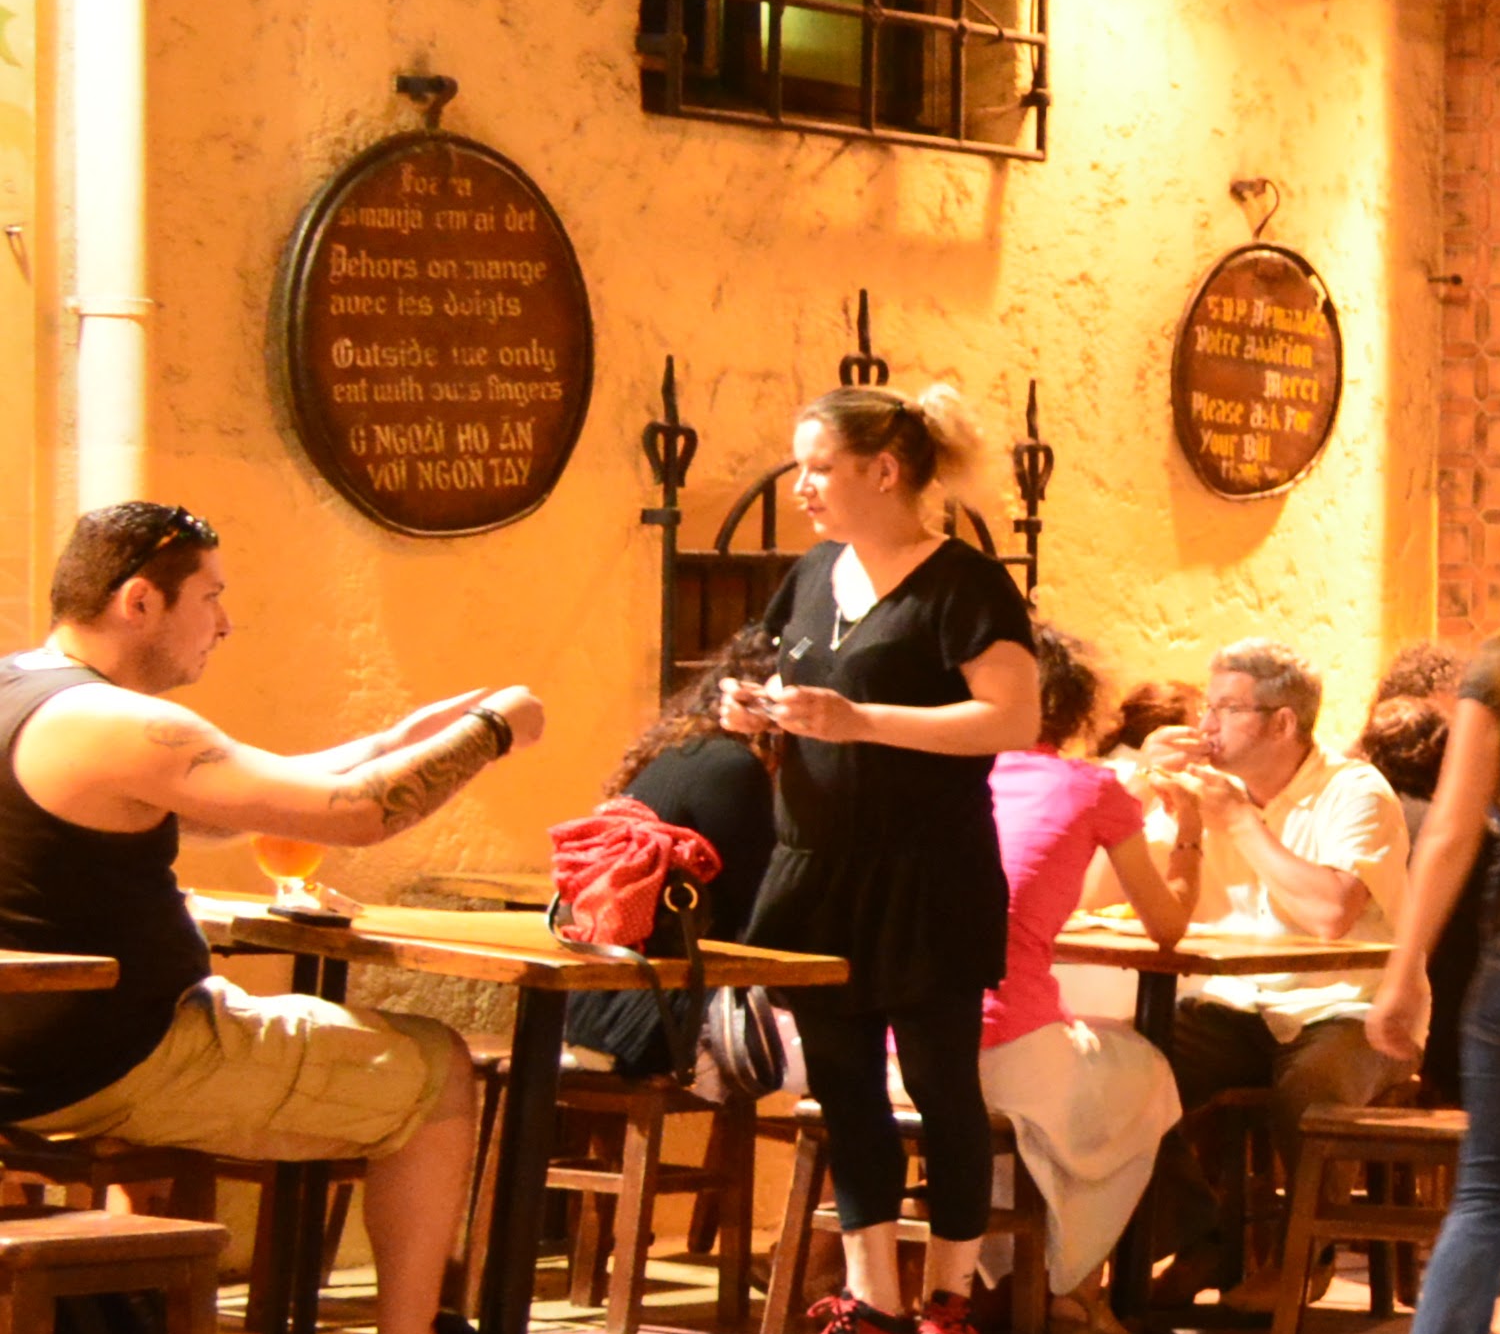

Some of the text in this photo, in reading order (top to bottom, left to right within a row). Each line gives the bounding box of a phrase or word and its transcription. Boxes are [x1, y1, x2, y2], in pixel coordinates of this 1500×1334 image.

[328, 242, 548, 287] Dehors on mange
[329, 287, 523, 325] avec les doigts
[331, 336, 558, 373] Outside we only
[331, 376, 369, 403] eat
[372, 372, 424, 403] with
[486, 372, 564, 408] fingers
[1262, 369, 1320, 404] Merci
[1191, 390, 1246, 426] Please
